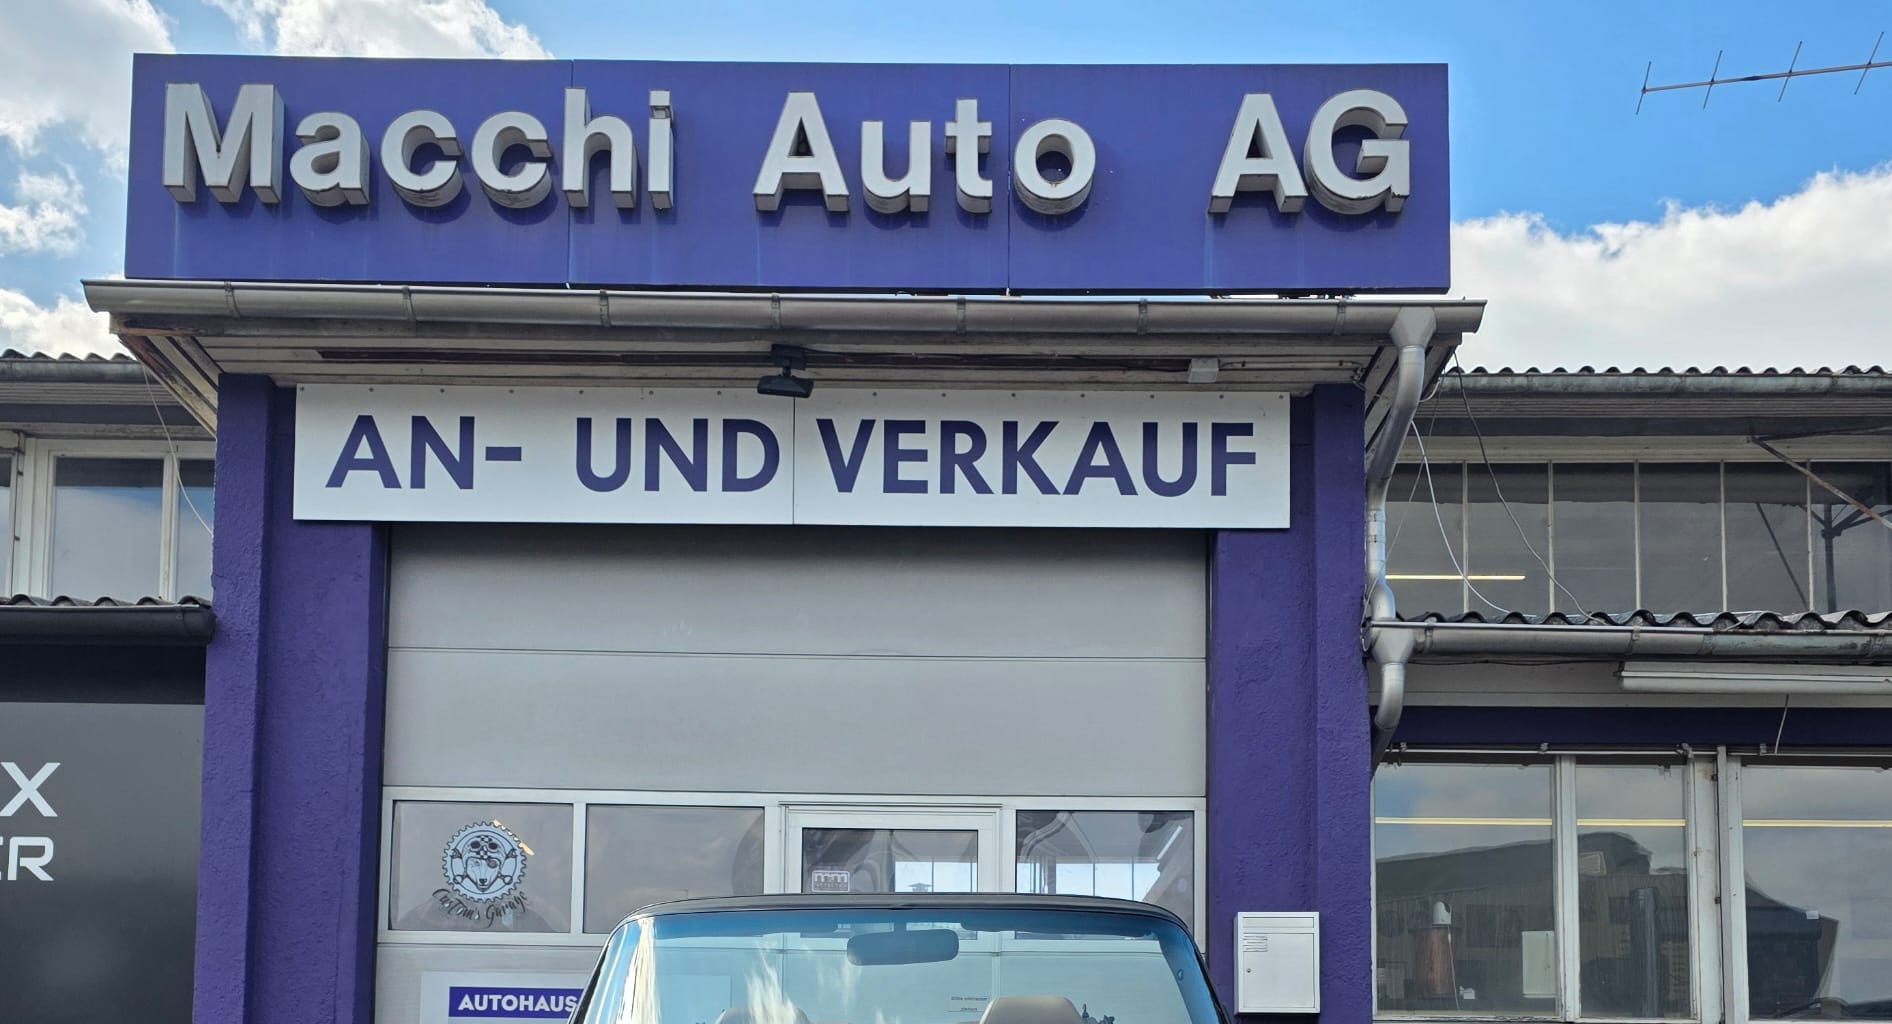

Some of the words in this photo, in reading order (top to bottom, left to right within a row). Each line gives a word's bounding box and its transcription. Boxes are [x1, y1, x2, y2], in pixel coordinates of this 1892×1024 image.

[162, 82, 674, 211] Macchi
[753, 91, 1097, 217] Auto
[1209, 88, 1412, 216] AG
[325, 414, 523, 491] AN-
[574, 417, 782, 492] UND
[816, 418, 1257, 497] VERKAUF
[0, 836, 54, 881] R
[457, 994, 577, 1012] AUTOHAUS
